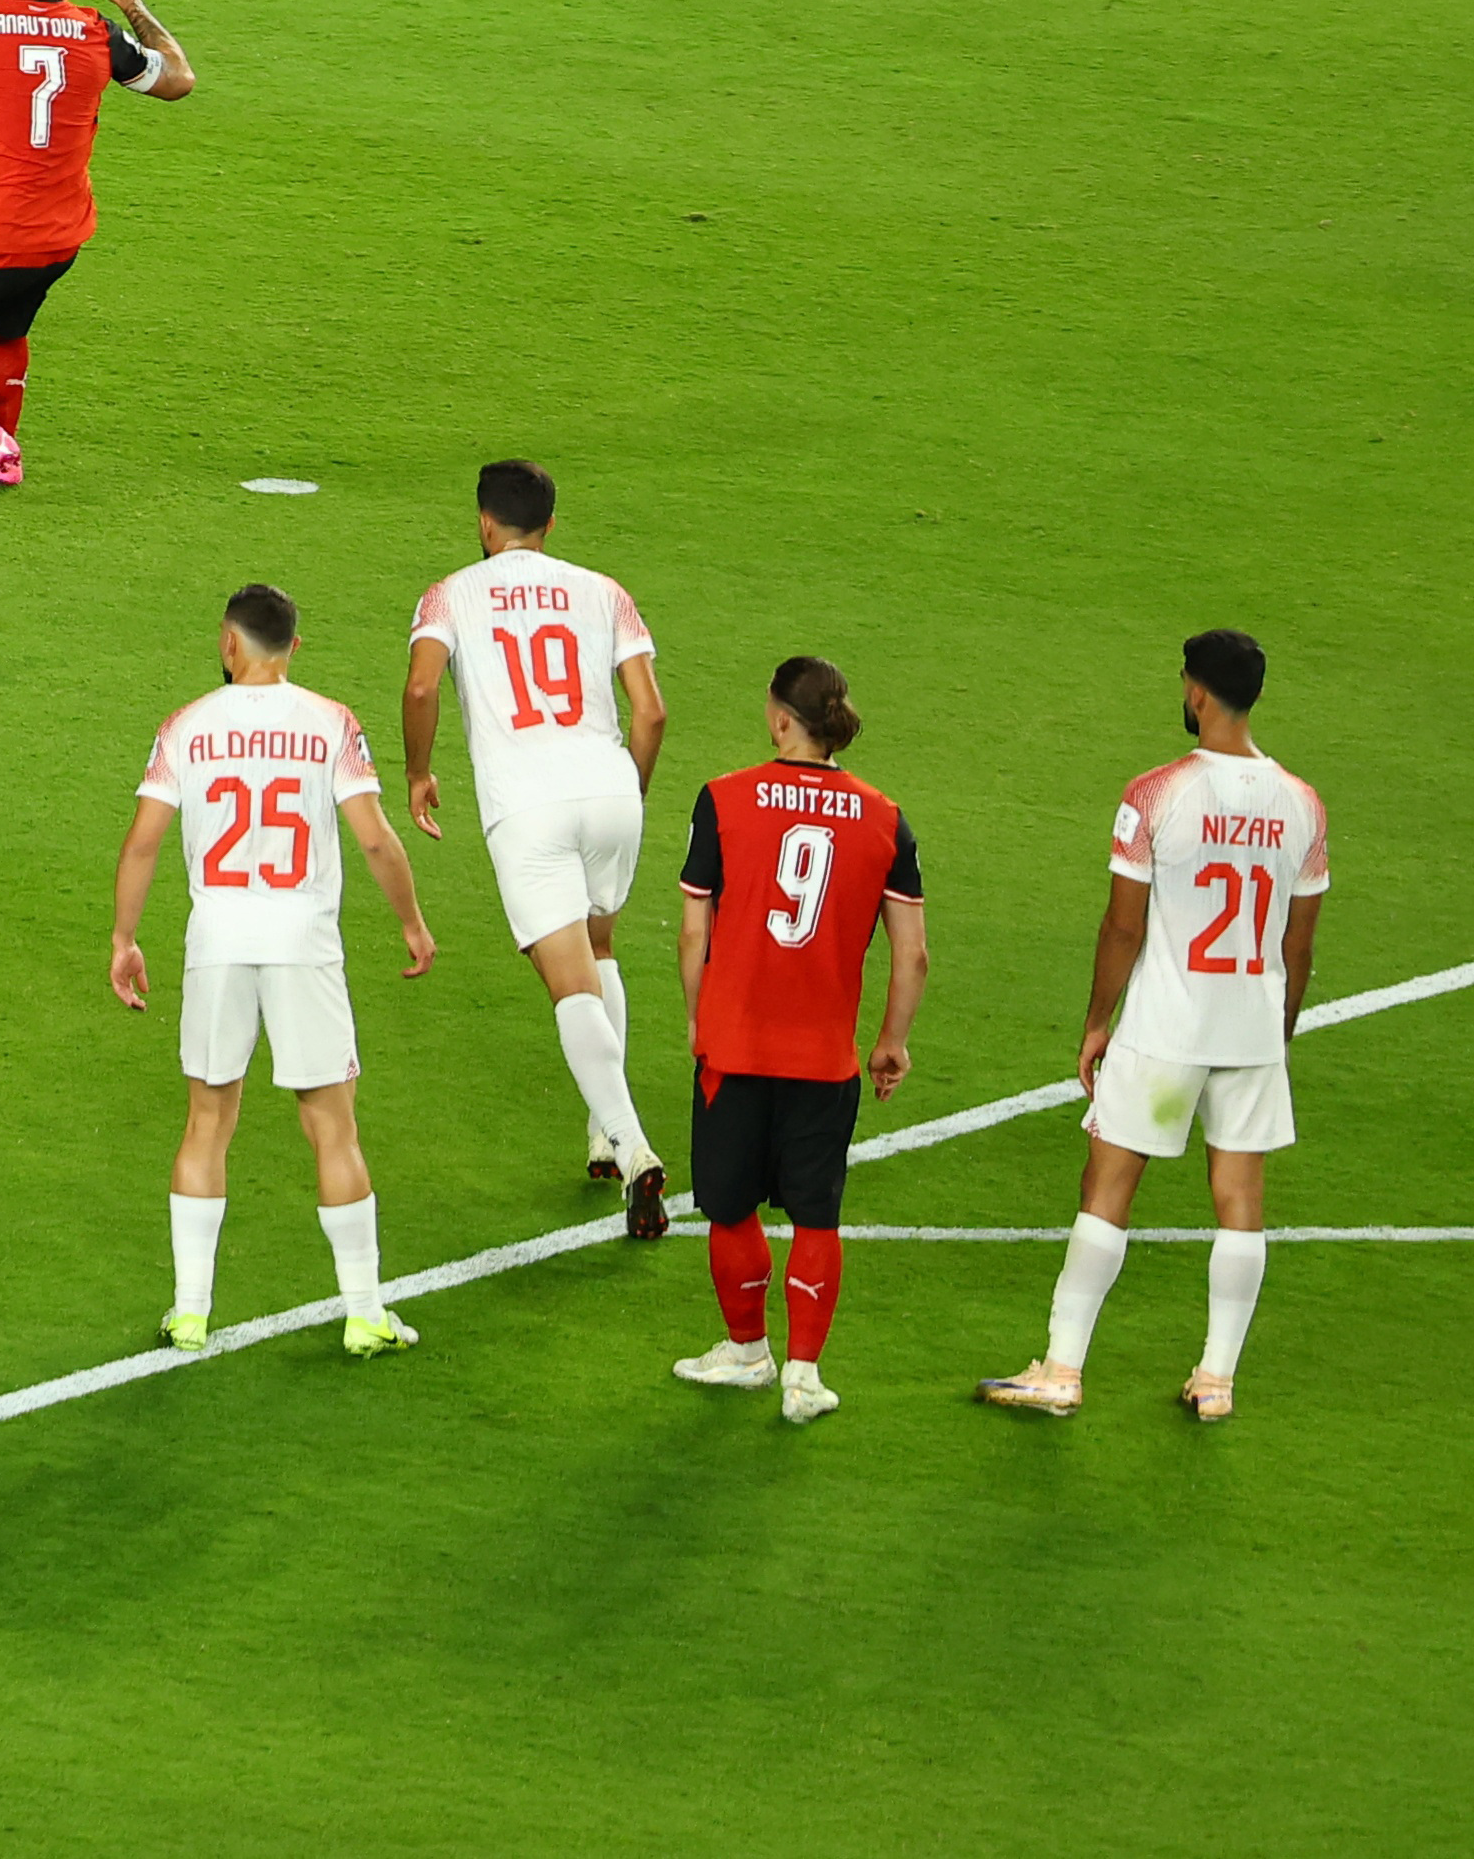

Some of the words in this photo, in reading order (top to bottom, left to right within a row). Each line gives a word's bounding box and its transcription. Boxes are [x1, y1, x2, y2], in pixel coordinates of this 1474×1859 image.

[19, 44, 70, 149] 7
[489, 585, 569, 611] SA'ED
[492, 624, 584, 731] 19
[189, 730, 328, 765] ALDAOUD
[203, 776, 311, 889] 25
[756, 781, 863, 821] SABITZER
[1202, 814, 1285, 849] NIZAR
[766, 823, 835, 949] 9
[1188, 862, 1274, 975] 21
